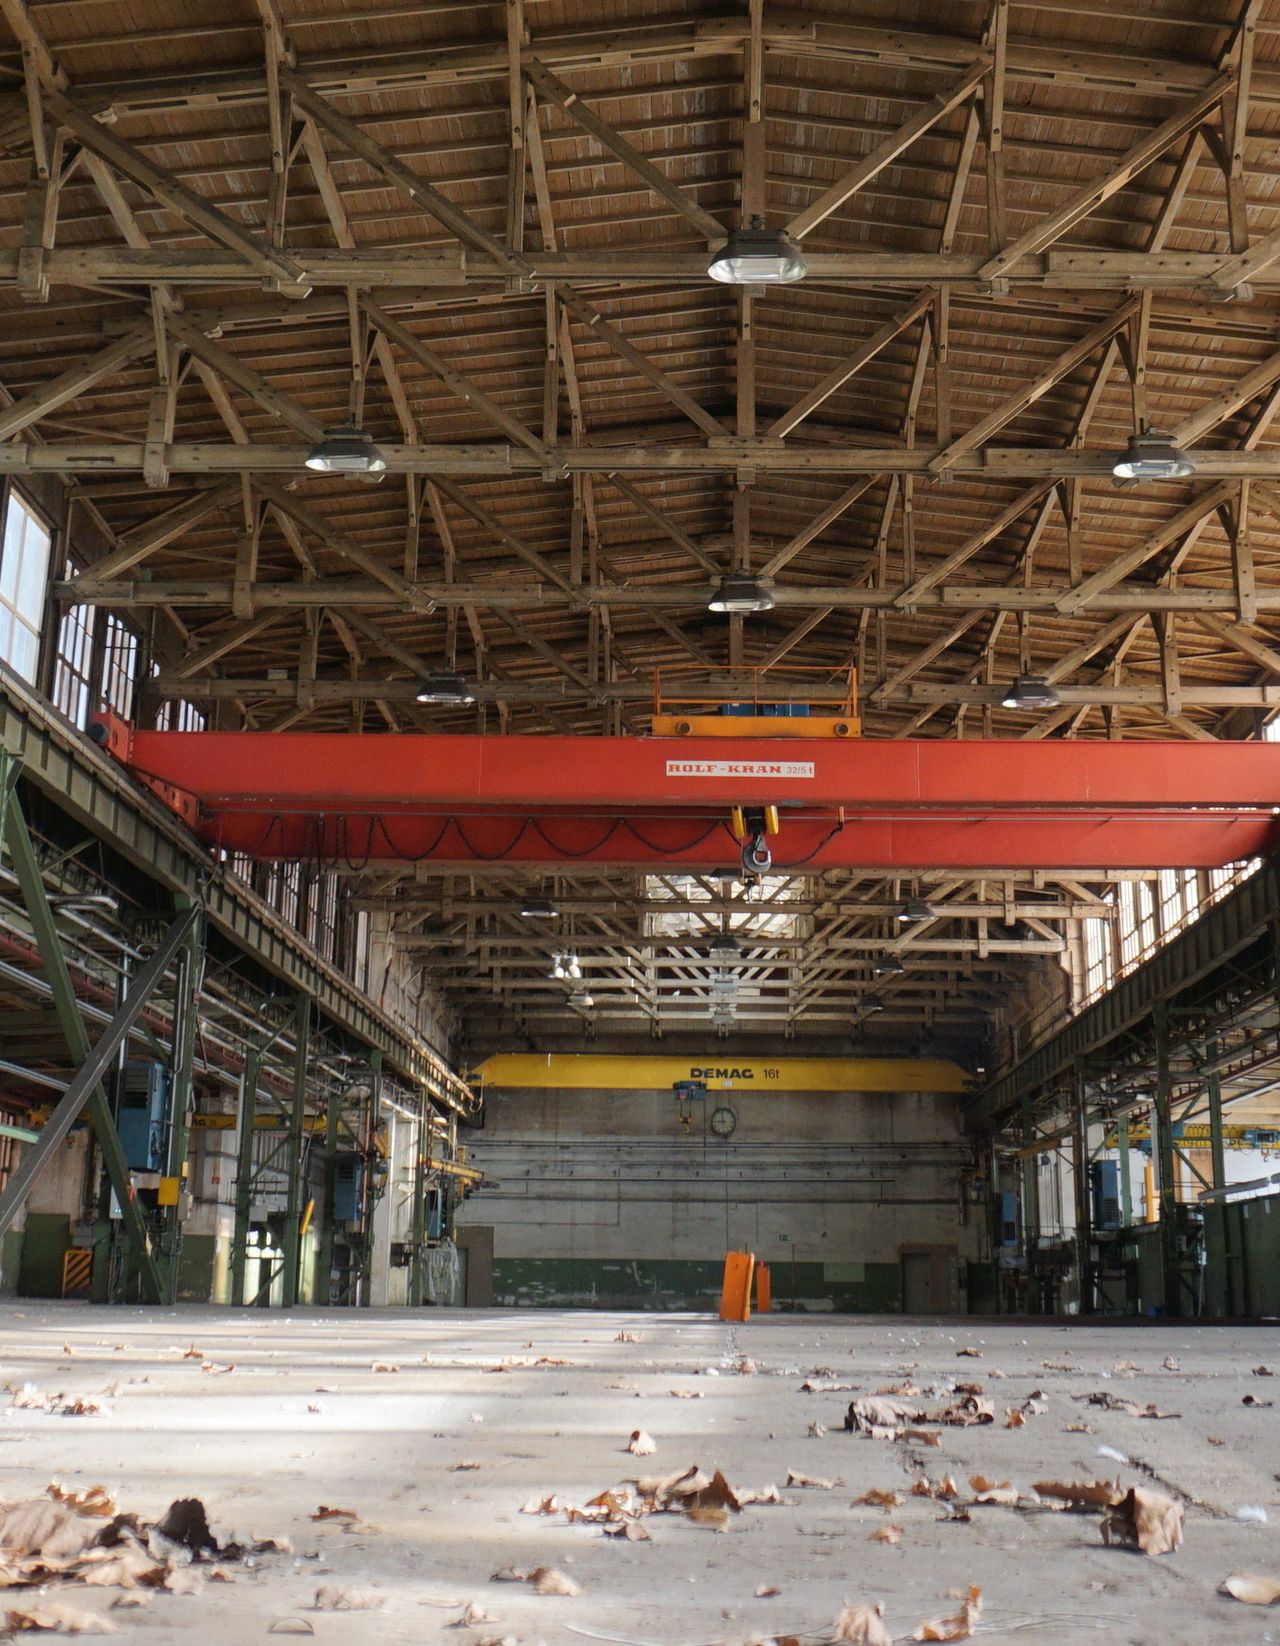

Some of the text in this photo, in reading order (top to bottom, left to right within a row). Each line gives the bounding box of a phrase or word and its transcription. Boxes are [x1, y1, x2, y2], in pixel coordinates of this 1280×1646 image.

[786, 766, 807, 775] 32/5
[690, 1068, 780, 1080] DEMAG 16t
